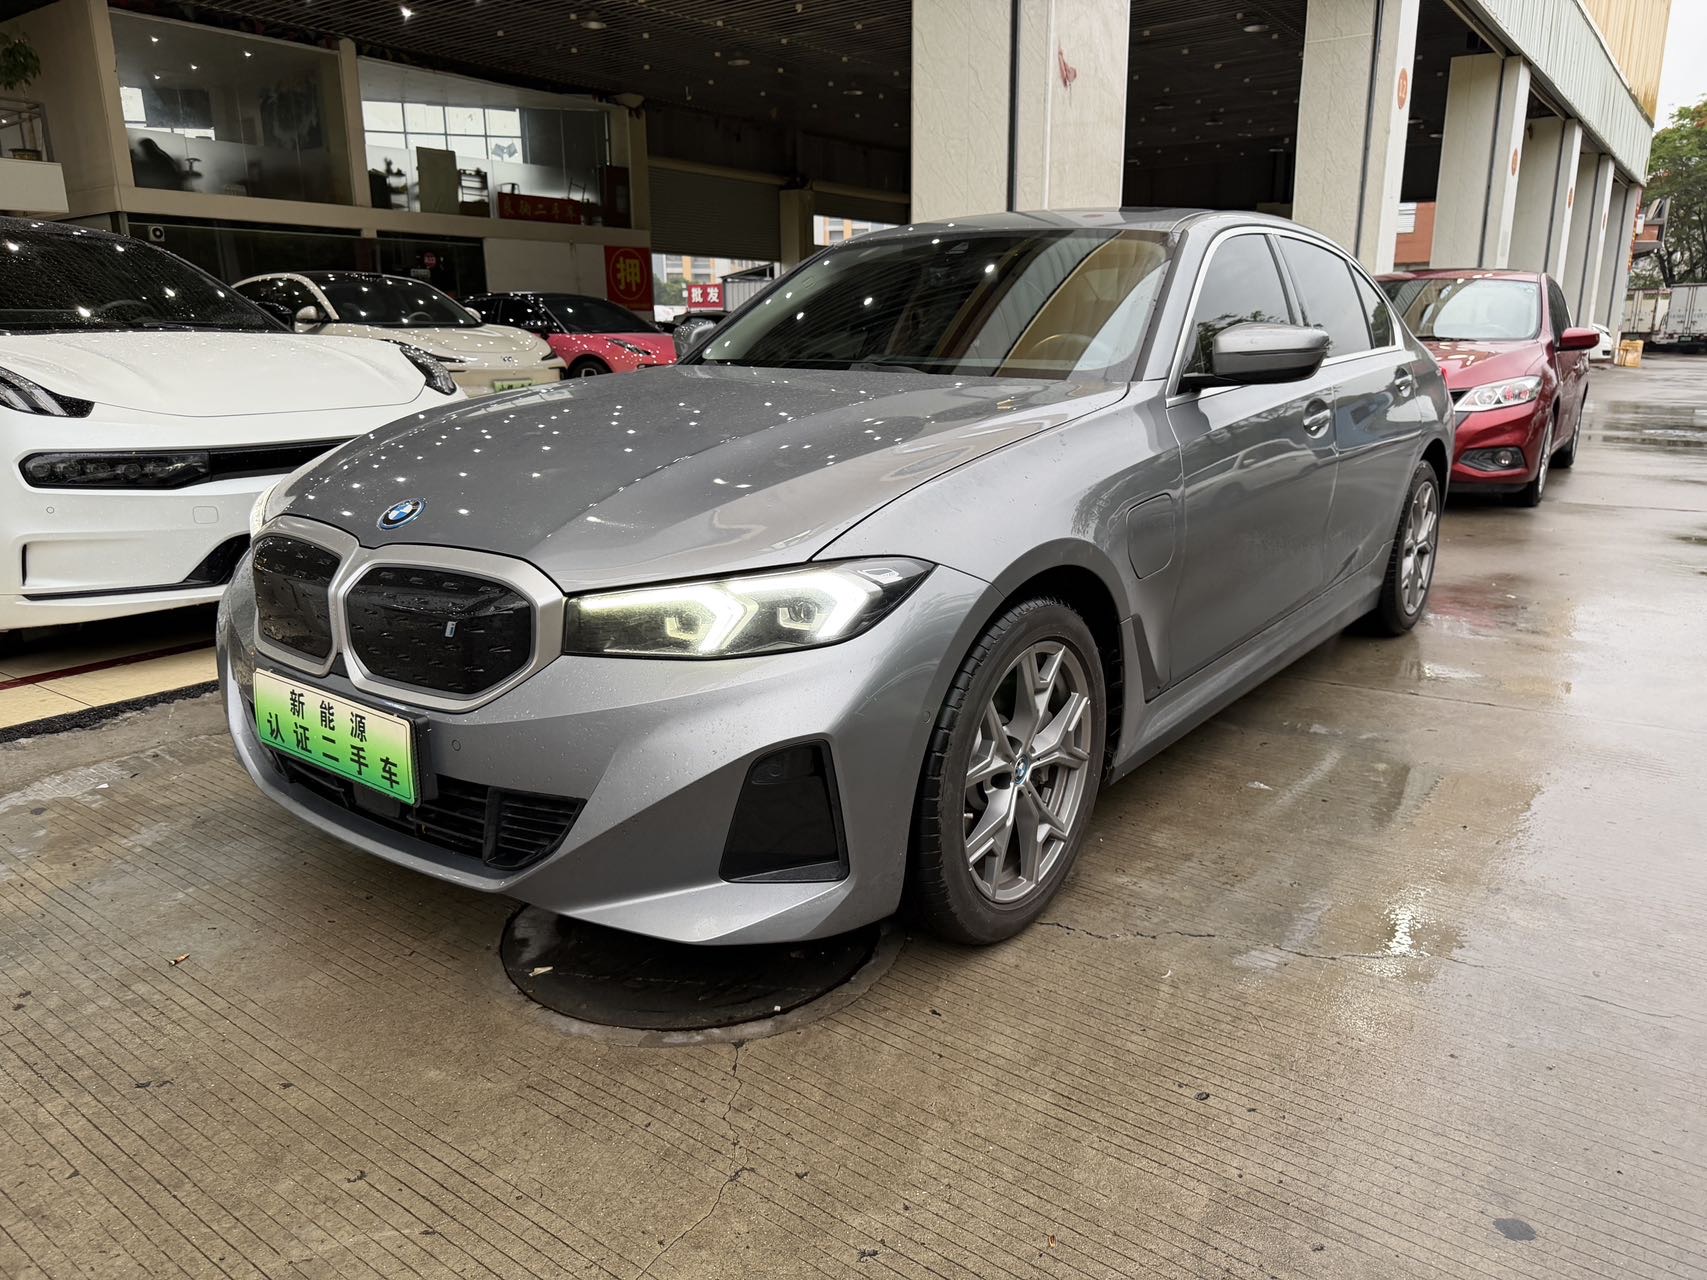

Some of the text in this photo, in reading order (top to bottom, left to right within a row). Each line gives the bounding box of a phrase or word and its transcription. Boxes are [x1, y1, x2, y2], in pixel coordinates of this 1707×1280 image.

[616, 256, 641, 292] 押
[690, 286, 720, 304] 批发
[290, 689, 367, 742] 新能源
[267, 712, 400, 788] 认证二手车
